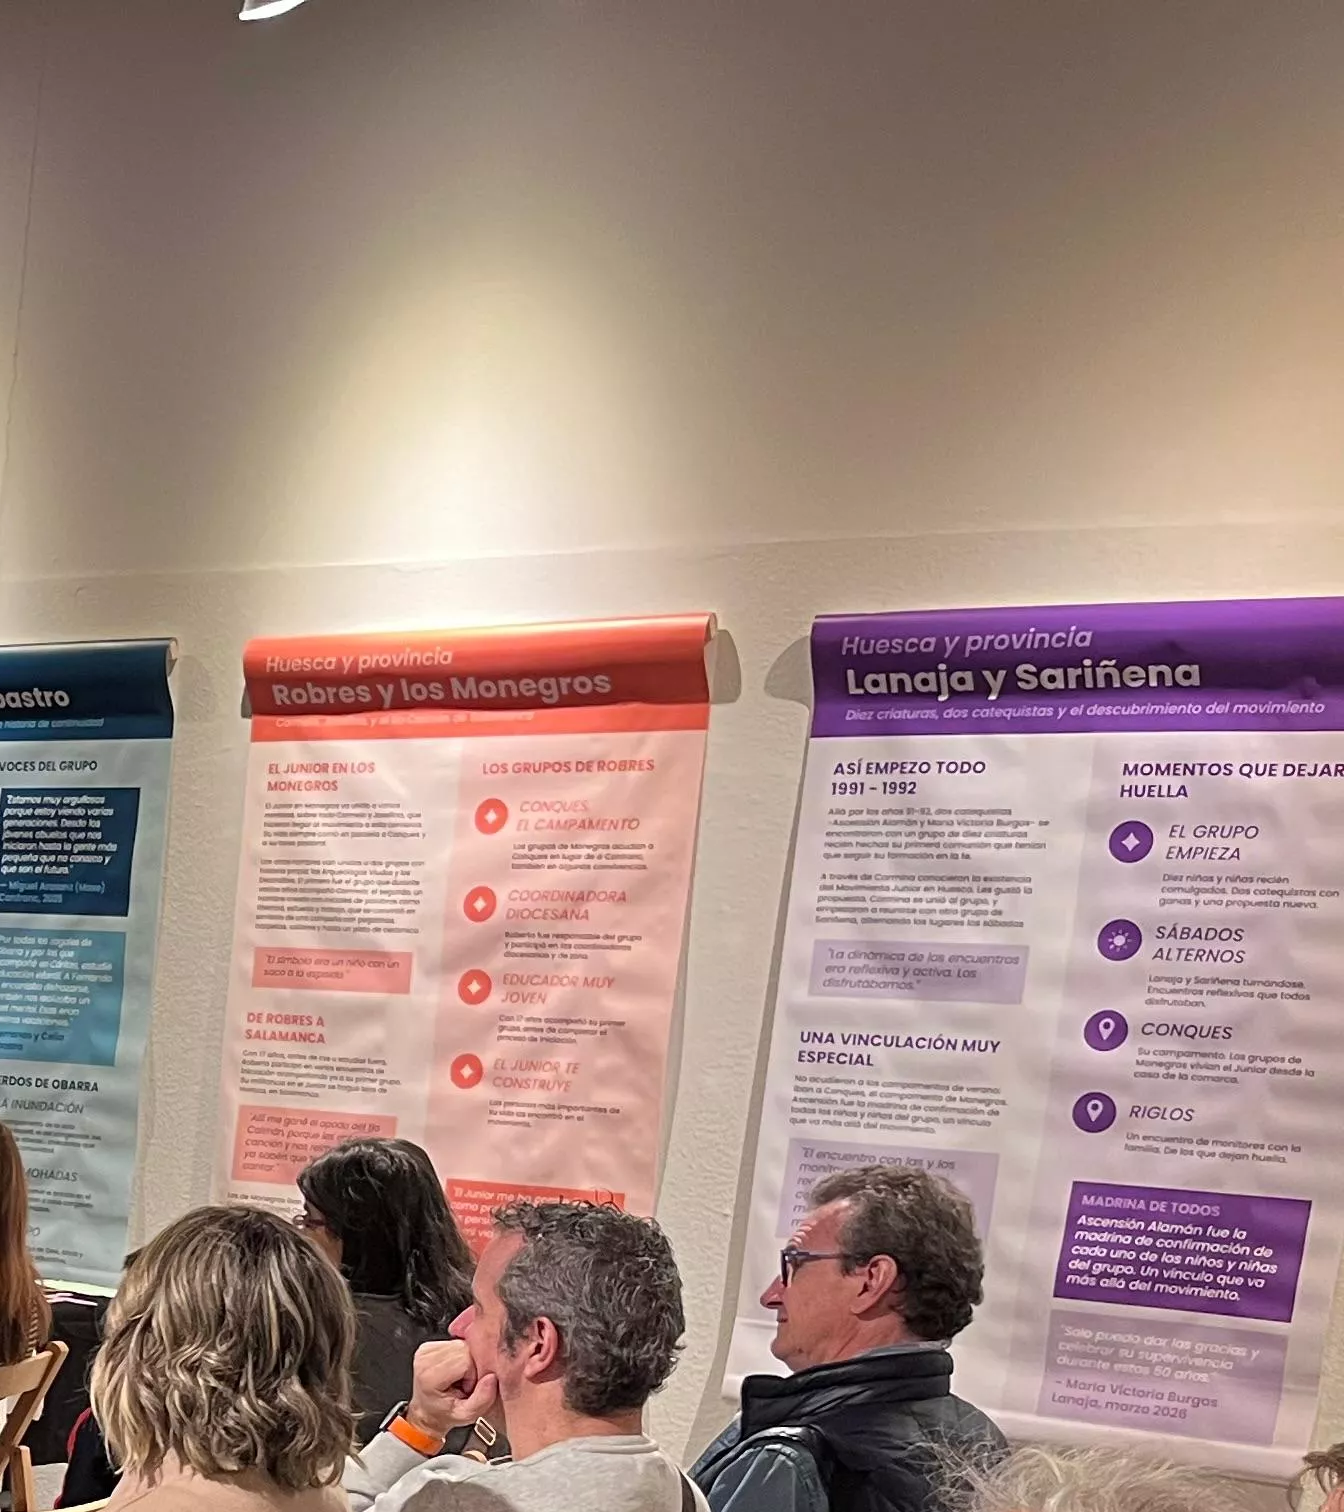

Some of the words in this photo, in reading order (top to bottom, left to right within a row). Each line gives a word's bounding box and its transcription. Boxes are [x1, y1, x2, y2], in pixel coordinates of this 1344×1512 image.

[842, 635, 937, 655] Huesca
[944, 635, 959, 658] y
[964, 626, 1092, 658] provincia
[266, 656, 337, 672] Huesca
[342, 656, 354, 674] y
[359, 647, 453, 673] provincia
[847, 663, 974, 702] Lanaja
[982, 669, 1007, 700] y
[1015, 658, 1201, 691] Sariñena
[272, 681, 372, 705] Robres
[377, 683, 394, 709] y
[400, 677, 444, 701] los
[450, 675, 612, 704] Monegros
[845, 709, 874, 721] Diez
[877, 708, 939, 720] criaturas,
[943, 707, 968, 719] dos
[972, 706, 1053, 719] catequistas
[1056, 705, 1069, 719] y
[1070, 704, 1084, 716] el
[1087, 702, 1202, 716] descubrimiento
[1206, 701, 1229, 714] del
[1233, 701, 1325, 714] movimiento
[0, 761, 35, 771] VOCES
[39, 761, 56, 771] DEL
[59, 761, 98, 771] GRUPO
[269, 763, 281, 774] EL
[283, 762, 329, 774] JUNIOR
[332, 762, 348, 774] EN
[351, 762, 375, 773] LOS
[482, 763, 509, 775] LOS
[512, 761, 572, 774] GRUPOS
[575, 760, 593, 773] DE
[597, 760, 655, 772] ROBRES
[833, 758, 863, 775] ASÍ
[866, 761, 931, 775] EMPEZO
[936, 761, 986, 774] TODO
[1122, 763, 1233, 777] MOMENTOS
[1239, 764, 1278, 778] QUE
[267, 780, 339, 792] MONEGROS
[831, 782, 865, 795] 1991
[882, 782, 917, 795] 1992
[1120, 785, 1188, 798] HUELLA
[516, 819, 528, 831] EL
[534, 818, 640, 830] CAMPAMENTO
[1169, 825, 1186, 838] EL
[1193, 825, 1259, 839] GRUPO
[1166, 846, 1241, 860] EMPIEZA
[508, 890, 627, 903] COORDINADORA
[506, 908, 590, 921] DIOCESANA
[1156, 923, 1244, 942] SÁBADOS
[1152, 948, 1246, 963] ALTERNOS
[503, 973, 577, 987] EDUCADOR
[583, 976, 615, 989] MUY
[501, 992, 548, 1005] JOVEN
[247, 1012, 263, 1024] DE
[266, 1013, 313, 1026] ROBRES
[316, 1016, 325, 1027] A
[245, 1029, 326, 1044] SALAMANCA
[1141, 1023, 1233, 1039] CONQUES
[800, 1032, 836, 1044] UNA
[841, 1033, 958, 1051] VINCULACIÓN
[962, 1039, 1001, 1053] MUY
[797, 1051, 874, 1066] ESPECIAL
[493, 1059, 507, 1070] EL
[512, 1059, 561, 1074] JUNIOR
[566, 1062, 581, 1074] TE
[35, 1078, 49, 1088] DE
[52, 1080, 98, 1092] OBARRA
[492, 1077, 572, 1092] CONSTRUYE
[11, 1099, 84, 1114] INUNDACIÓN
[1129, 1105, 1195, 1121] RIGLOS
[1082, 1195, 1146, 1211] MADRINA
[1150, 1200, 1166, 1212] DE
[1172, 1202, 1220, 1217] TODOS
[1077, 1215, 1145, 1231] Ascensión
[1147, 1221, 1203, 1236] Alamán
[1207, 1226, 1230, 1239] fue
[1233, 1228, 1247, 1240] la
[1074, 1230, 1132, 1244] madrina
[1135, 1234, 1153, 1247] de
[1156, 1237, 1250, 1257] confirmación
[1254, 1246, 1273, 1258] de
[1072, 1245, 1107, 1257] cada
[1110, 1249, 1136, 1260] uno
[1139, 1250, 1158, 1262] de
[1161, 1252, 1181, 1264] los
[1185, 1255, 1223, 1268] niños
[1226, 1260, 1236, 1272] y
[1238, 1260, 1278, 1274] niñas
[1069, 1259, 1091, 1270] del
[1092, 1263, 1136, 1276] grupo.
[1140, 1266, 1159, 1277] Un
[1163, 1267, 1213, 1282] vínculo
[1217, 1273, 1244, 1287] que
[1247, 1278, 1265, 1288] va
[1066, 1273, 1096, 1286] más
[1100, 1278, 1125, 1289] allá
[1129, 1279, 1151, 1291] del
[1154, 1283, 1240, 1301] movimiento.
[1066, 1379, 1106, 1393] María
[1110, 1382, 1165, 1400] Victoria
[1167, 1392, 1218, 1408] Burgos
[1051, 1393, 1101, 1409] Lanaja,
[1105, 1400, 1150, 1414] marzo
[1153, 1405, 1188, 1420] 2026
